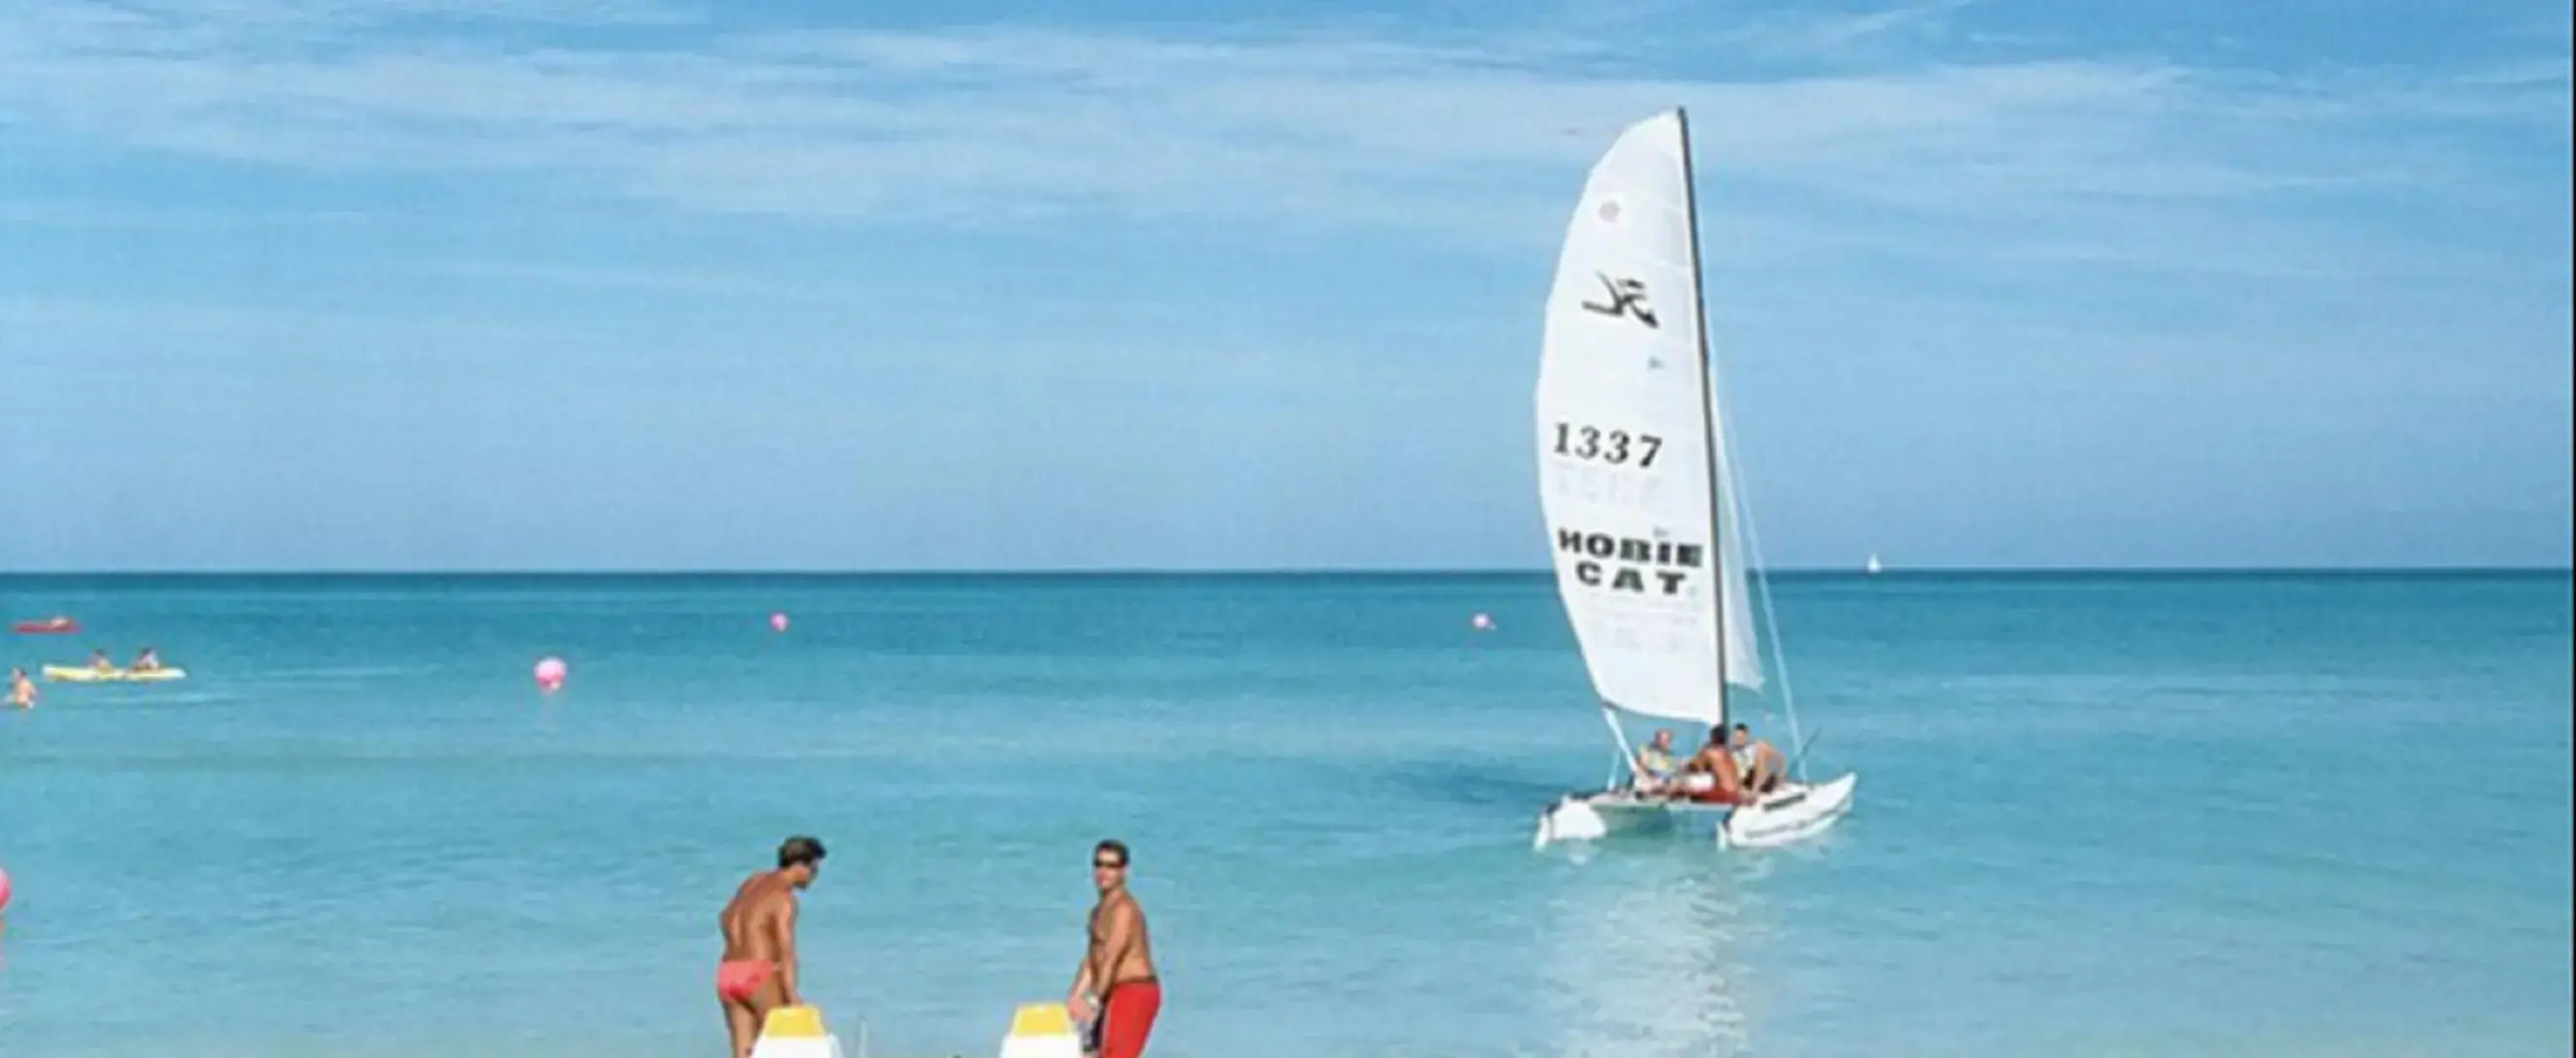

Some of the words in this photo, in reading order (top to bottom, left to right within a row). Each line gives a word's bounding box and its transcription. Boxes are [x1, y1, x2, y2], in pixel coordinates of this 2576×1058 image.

[1553, 422, 1662, 467] 1337
[1558, 528, 1702, 566] HOBIE
[1575, 561, 1687, 594] CAT
